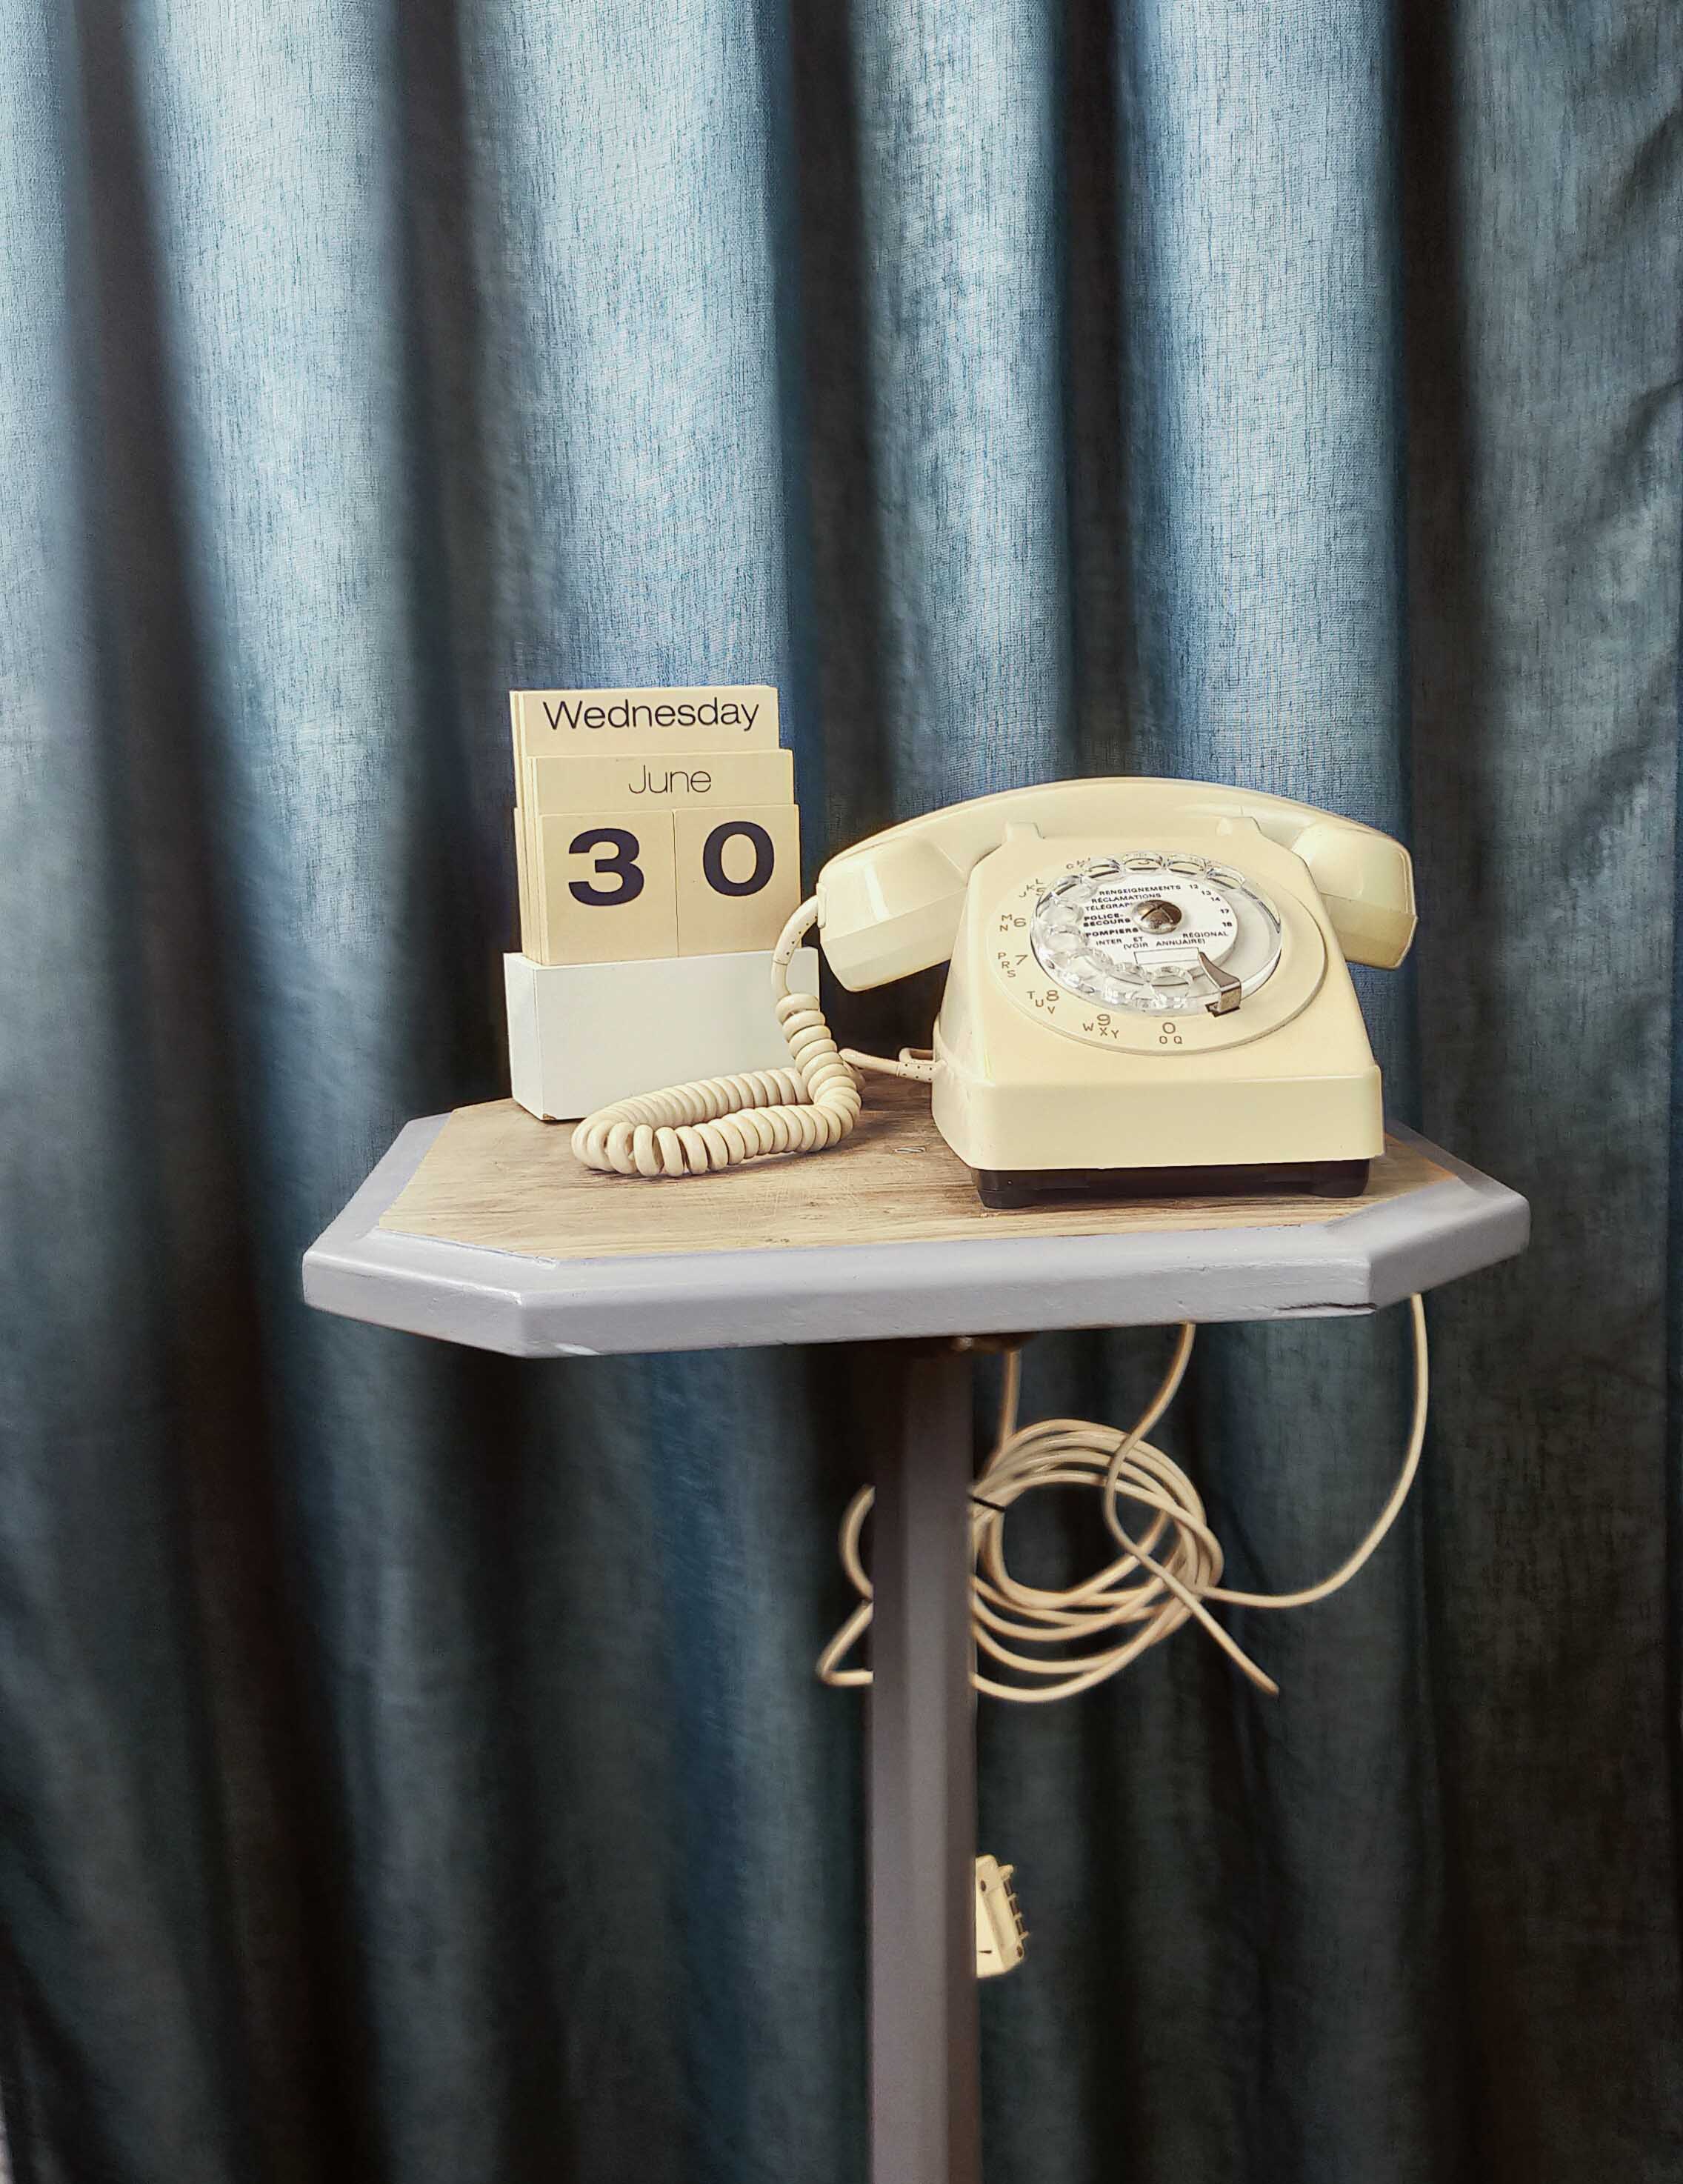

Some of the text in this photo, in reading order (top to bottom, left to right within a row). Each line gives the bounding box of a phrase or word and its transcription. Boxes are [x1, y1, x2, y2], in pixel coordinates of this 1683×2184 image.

[543, 697, 759, 732] Wednesday
[628, 765, 712, 794] June
[1099, 885, 1181, 896] RENSEIGNEMENTS
[1091, 893, 1162, 904] RÉCLAMATIONS
[1084, 902, 1133, 912] TÉLÉGRAP
[1013, 917, 1027, 928] 6
[1083, 918, 1131, 928] SECOURS
[1085, 927, 1139, 937] POMPIERS
[1096, 938, 1122, 946] INTER
[1015, 954, 1028, 966] 7
[1046, 990, 1059, 1002] 8
[1096, 1013, 1111, 1026] 9
